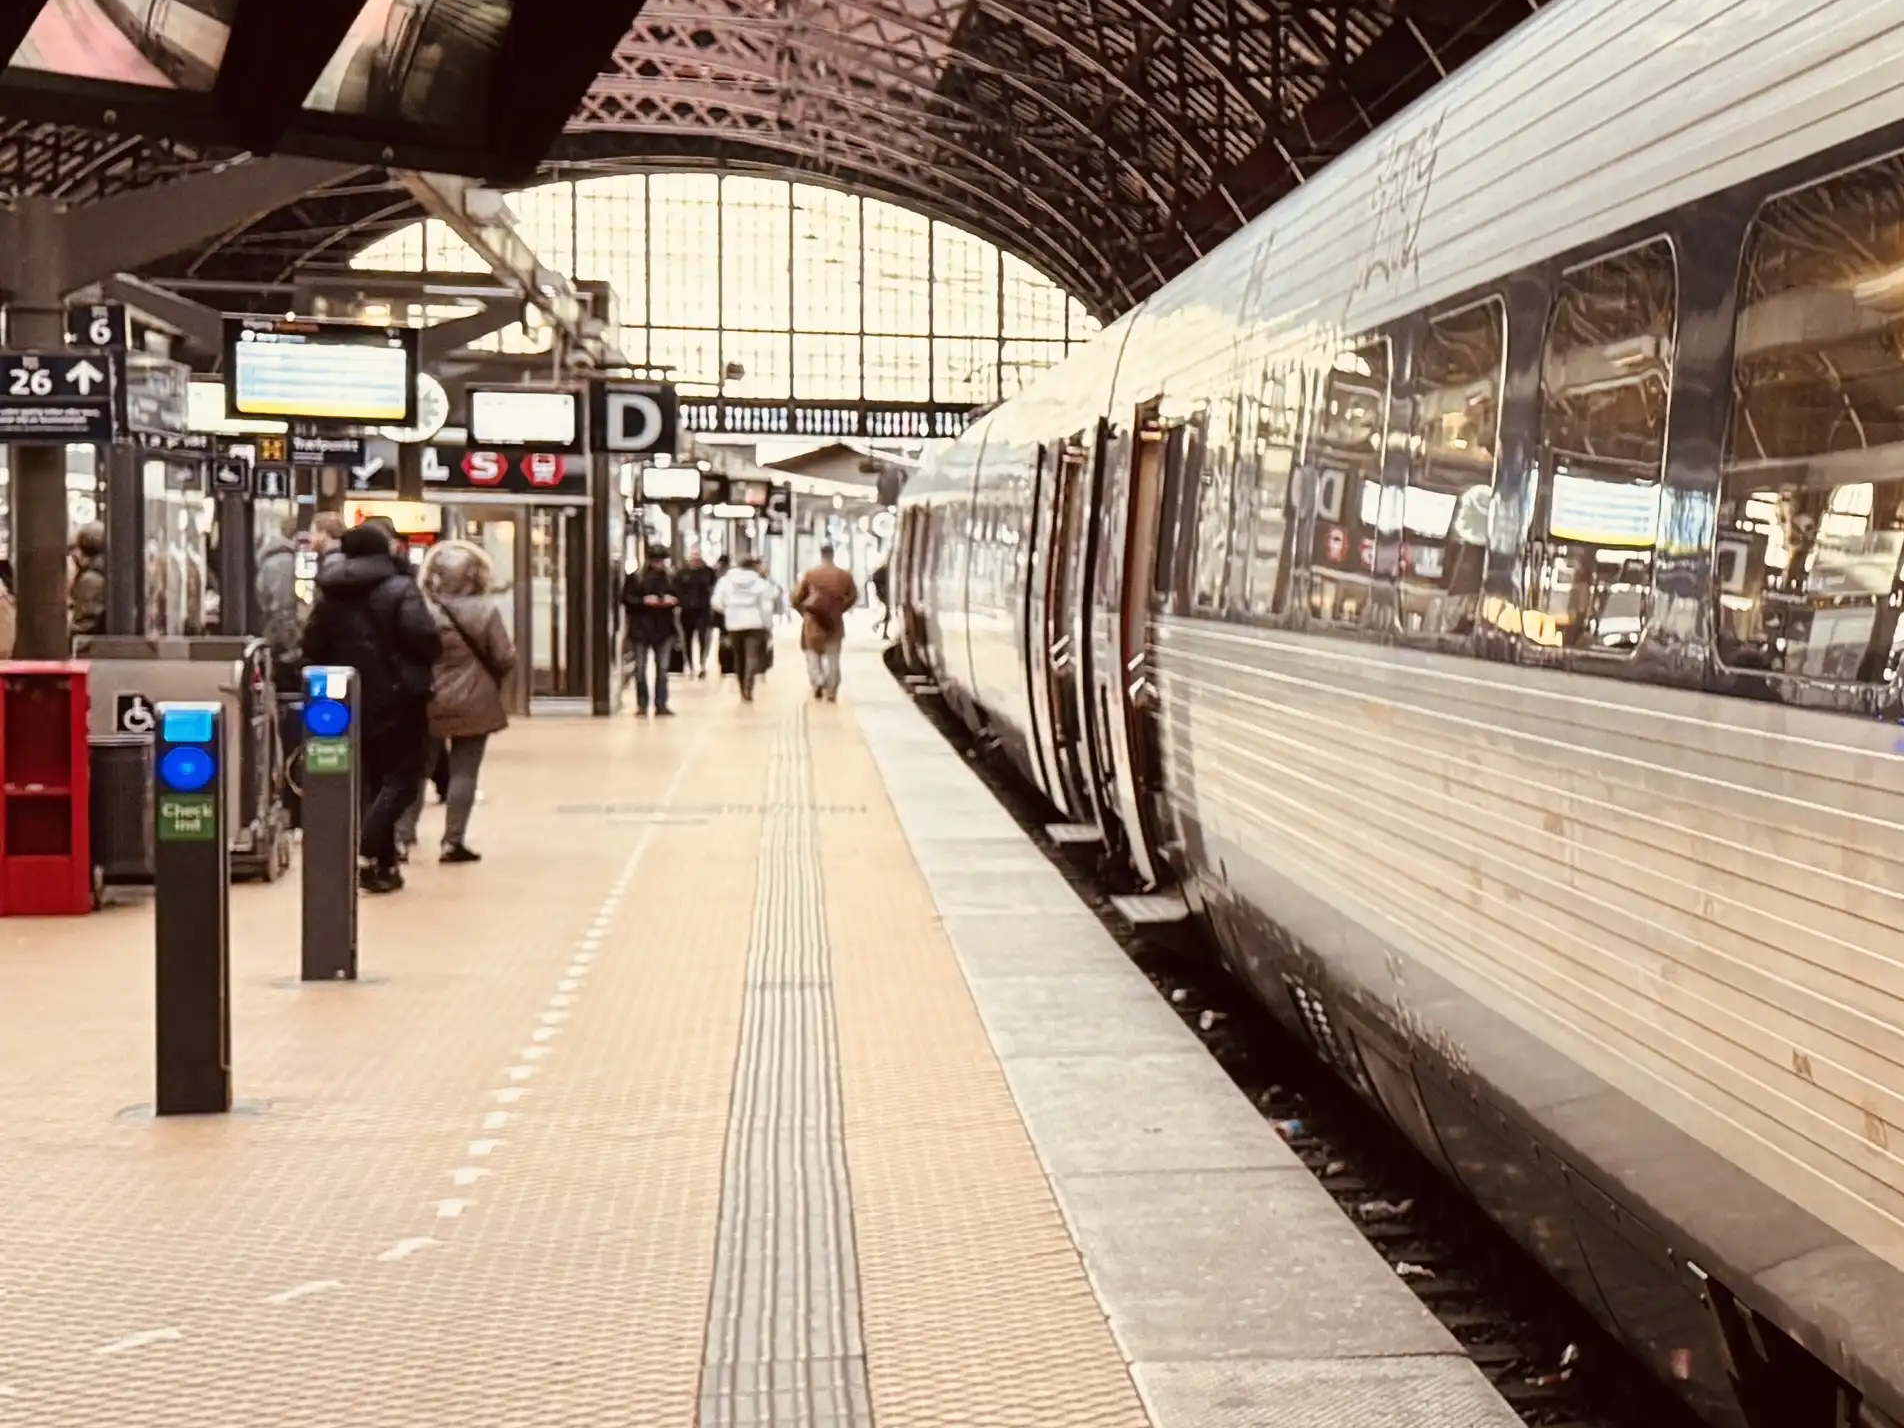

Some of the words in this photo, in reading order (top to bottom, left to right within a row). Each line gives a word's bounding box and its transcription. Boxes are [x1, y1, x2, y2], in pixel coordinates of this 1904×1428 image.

[89, 318, 112, 345] 6
[9, 368, 52, 396] 26
[606, 392, 662, 451] D
[471, 452, 498, 479] S
[161, 803, 213, 818] Check
